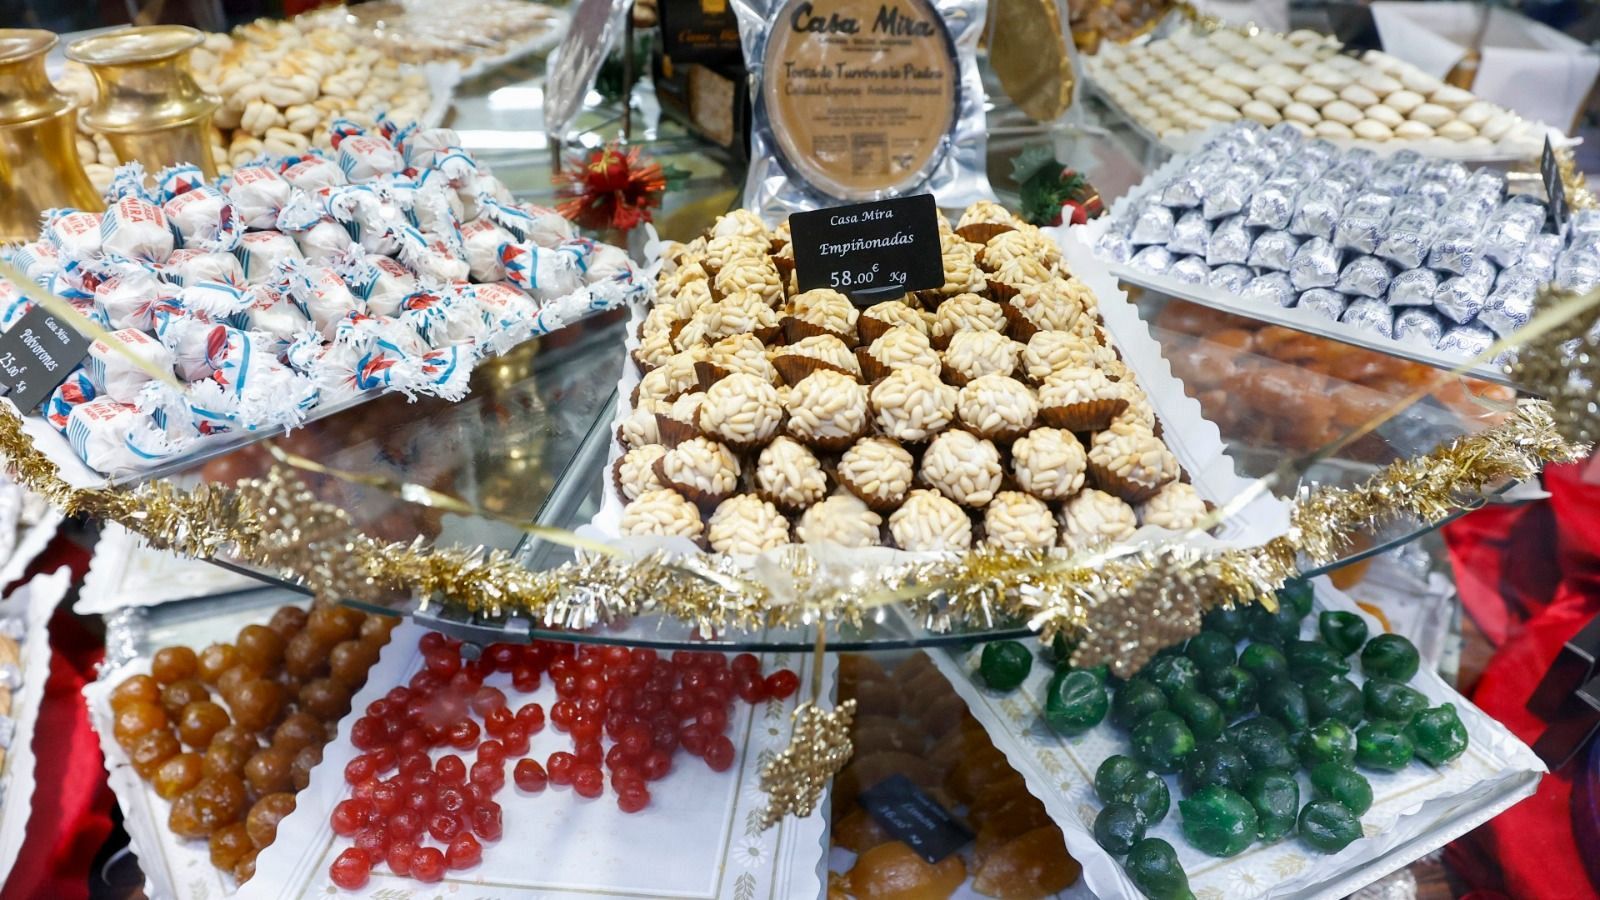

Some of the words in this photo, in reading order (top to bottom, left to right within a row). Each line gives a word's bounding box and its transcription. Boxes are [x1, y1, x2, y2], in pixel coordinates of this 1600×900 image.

[790, 2, 860, 34] Casa
[872, 4, 935, 36] Mira
[127, 197, 143, 222] MIRA
[830, 214, 858, 226] Casa
[861, 209, 894, 222] Mira
[819, 231, 914, 257] Empiñonadas
[889, 271, 907, 284] Kg
[44, 317, 59, 332] Casa
[54, 328, 71, 345] Mira
[19, 328, 59, 372] Polvorones
